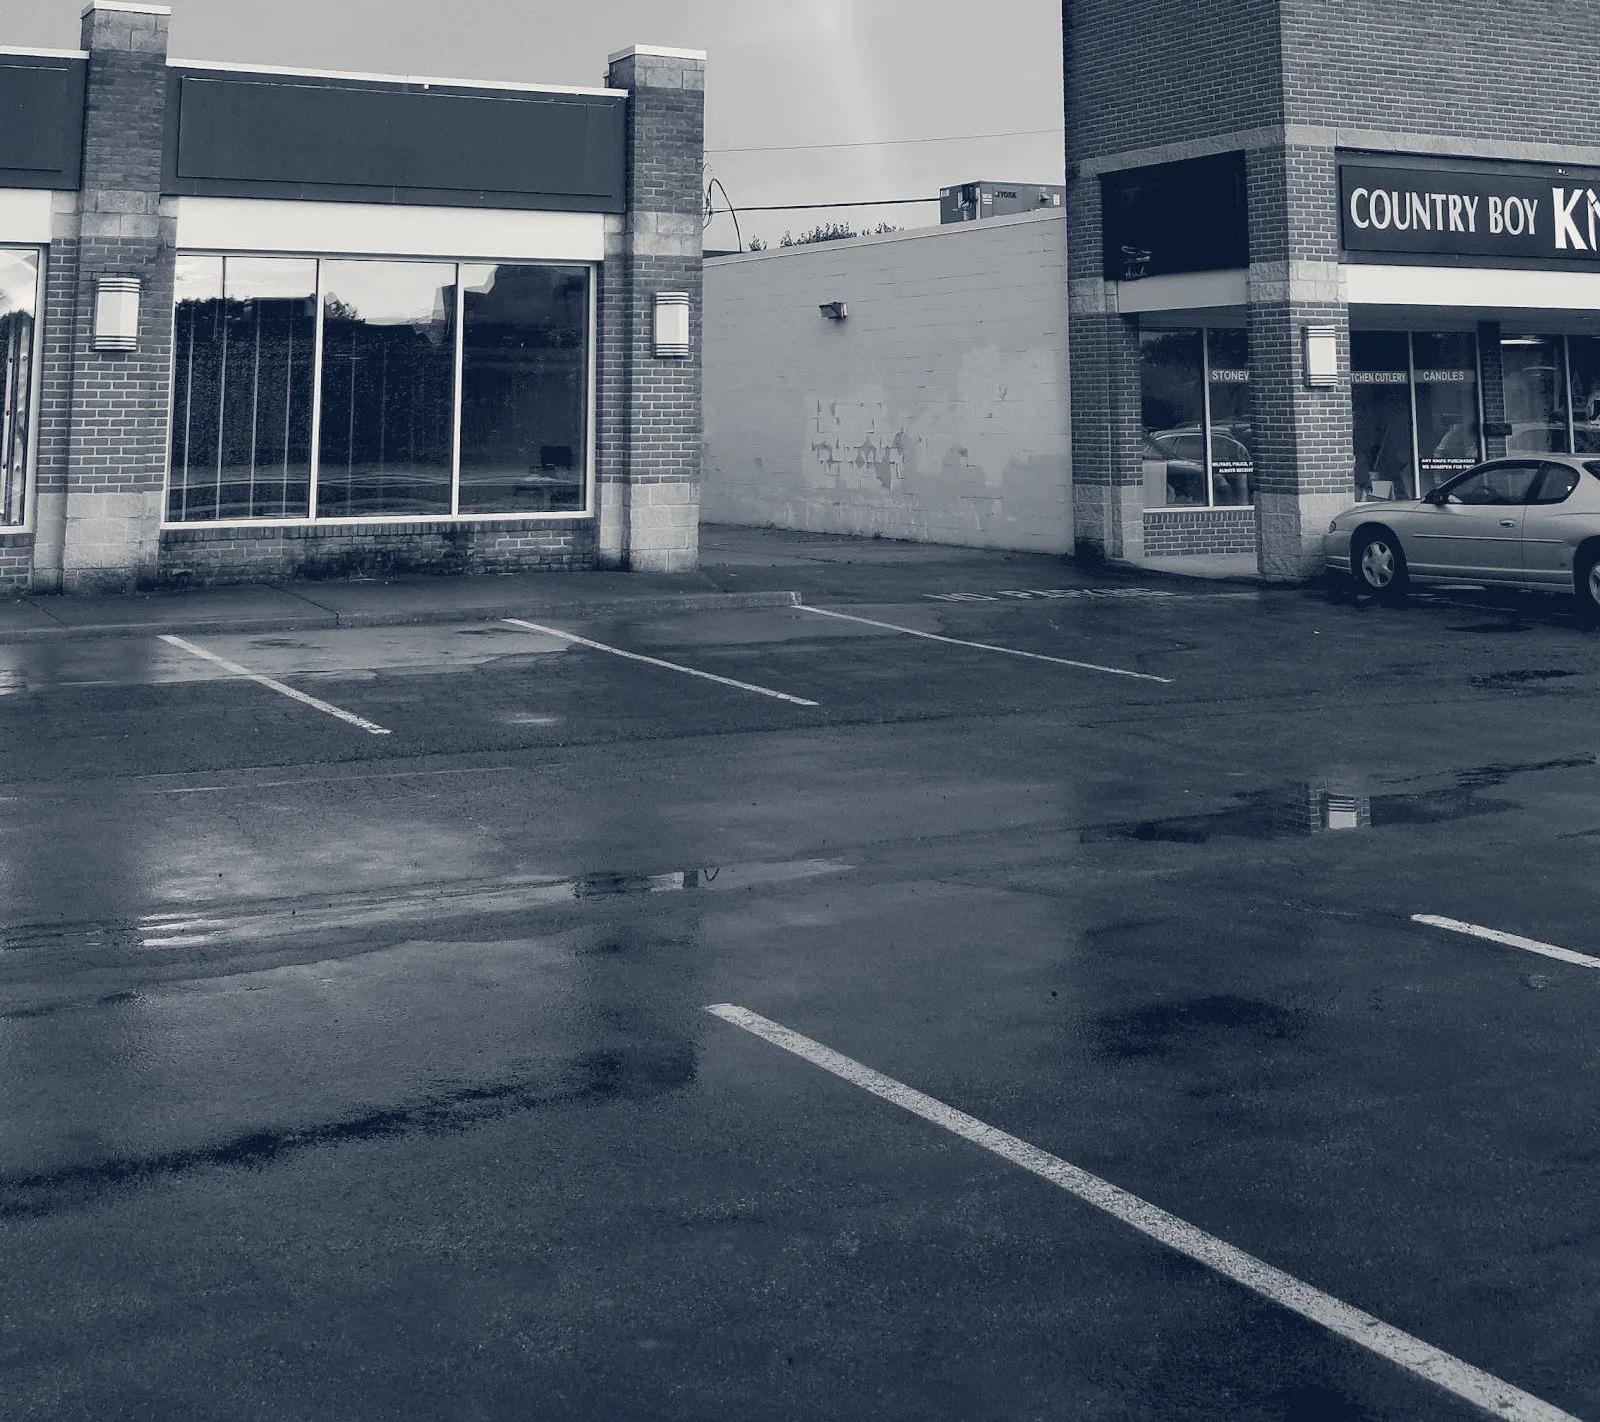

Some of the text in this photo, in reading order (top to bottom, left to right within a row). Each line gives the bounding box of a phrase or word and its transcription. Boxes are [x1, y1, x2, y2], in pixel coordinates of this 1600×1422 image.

[1000, 191, 1017, 199] YORK
[1350, 187, 1479, 233] COUNTRY
[1488, 196, 1538, 235] BOY
[1375, 373, 1406, 382] CUTLERY
[1423, 371, 1464, 381] CANDLES
